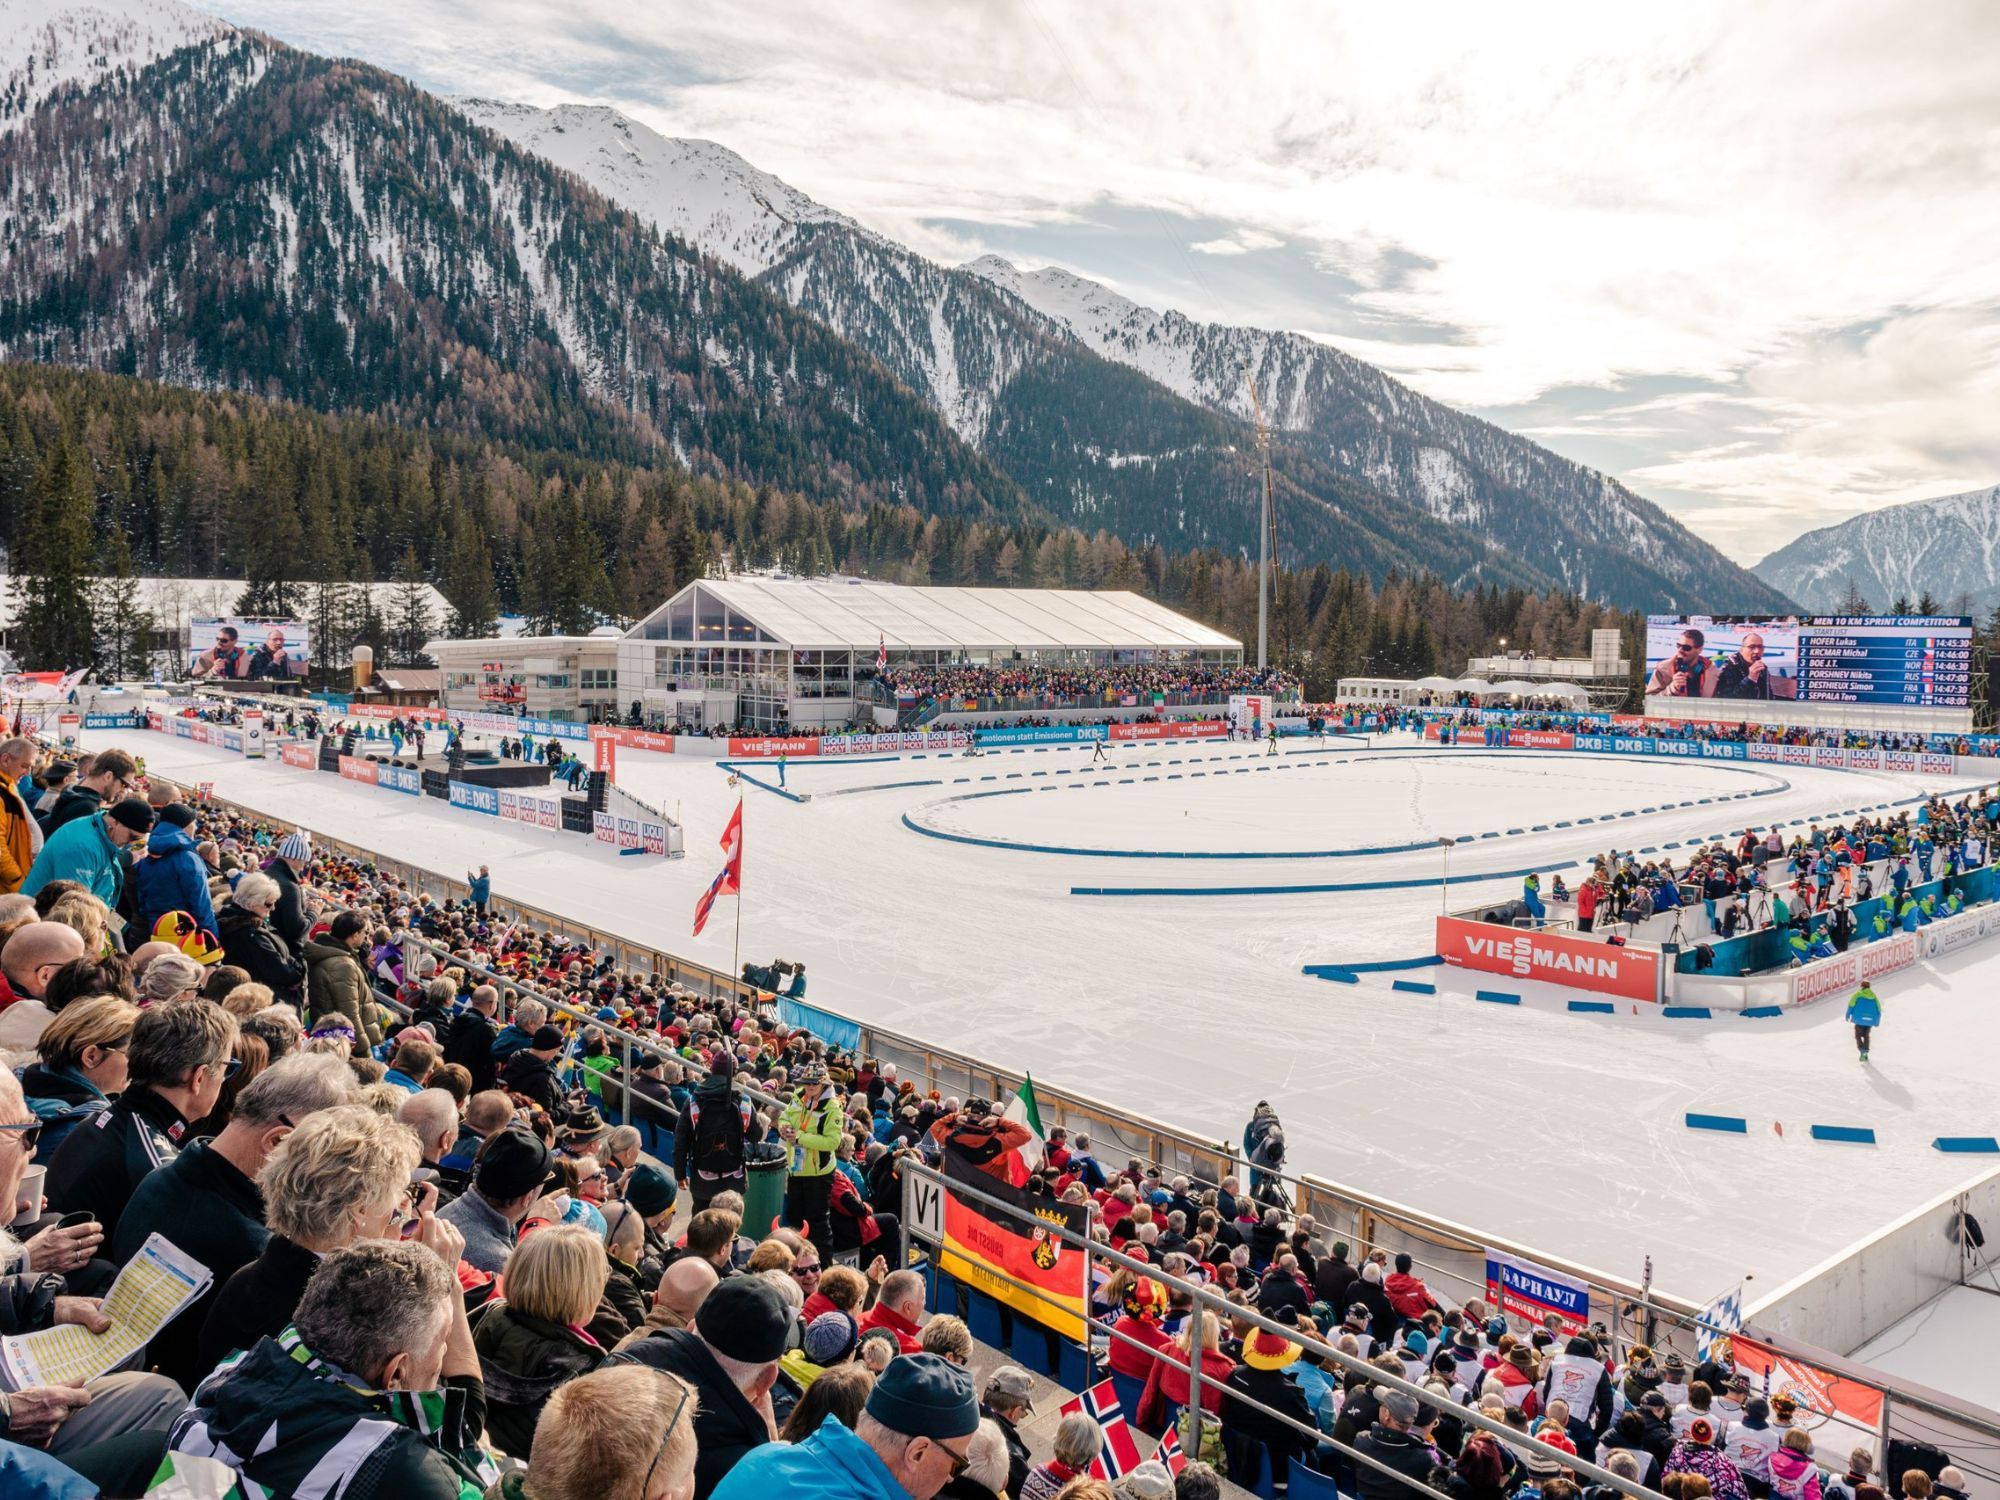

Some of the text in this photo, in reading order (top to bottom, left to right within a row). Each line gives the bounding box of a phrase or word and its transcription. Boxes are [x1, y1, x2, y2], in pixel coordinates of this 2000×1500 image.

[1813, 617, 1960, 626] MEN 10 KM SPRINT COMPETITION
[1813, 628, 1848, 636] START LIST
[1810, 638, 1835, 646] HOFER
[1835, 638, 1857, 646] Lukas
[1905, 639, 1917, 647] ITA
[1936, 639, 1970, 648] 14:45:30
[1809, 648, 1842, 657] KRCMAR
[1842, 649, 1868, 657] Michal
[1905, 650, 1919, 658] CZE
[1935, 650, 1969, 660] 14:46:00
[1809, 659, 1824, 668] BOE
[1825, 659, 1838, 668] J.T.
[1904, 661, 1921, 670] NOR
[1935, 662, 1969, 671] 14:46:30
[1808, 670, 1850, 679] PORSHNEV
[1850, 671, 1873, 680] Nikita
[1904, 672, 1920, 681] RUS
[1934, 673, 1968, 682] 14:47:00
[1808, 681, 1849, 690] DESTHIEUX
[1849, 682, 1874, 690] Simon
[1903, 683, 1919, 692] FRA
[1933, 684, 1968, 694] 14:47:30
[1807, 692, 1840, 701] SEPPALA
[1840, 693, 1857, 701] Tero
[1903, 695, 1916, 703] FIN
[1933, 696, 1967, 706] 14:48:00
[87, 718, 107, 728] DKB
[1179, 722, 1219, 736] VIESSMANN
[877, 734, 899, 743] LIQUI
[903, 733, 924, 742] LIQUI
[928, 732, 948, 741] LIQUI
[980, 731, 1073, 743] motionen statt Emissionen
[1077, 729, 1099, 740] DKB
[1118, 726, 1160, 739] VIESSMANN
[823, 736, 846, 745] LIQUI
[851, 735, 873, 744] LIQUI
[903, 741, 924, 750] MOLY
[928, 740, 948, 749] MOLY
[952, 740, 967, 748] MOL
[1508, 732, 1561, 747] VIESSMANN
[1575, 737, 1602, 750] DKB
[1615, 738, 1643, 752] DKB
[742, 739, 806, 756] VIESSMANN
[823, 745, 846, 754] MOLY
[851, 744, 873, 753] MOLY
[877, 742, 899, 752] MOLY
[1659, 741, 1688, 755] DKB
[1703, 744, 1733, 758] DKB
[1752, 745, 1777, 754] LIQUI
[1784, 747, 1810, 756] LIQUI
[1752, 753, 1777, 761] MOLY
[1784, 755, 1810, 764] MOLY
[1817, 749, 1843, 758] LIQUI
[1852, 751, 1880, 760] LIQUI
[1886, 753, 1915, 762] LIQUI
[1817, 757, 1843, 767] MOLY
[1851, 759, 1879, 769] MOLY
[1886, 761, 1914, 771] MOLY
[1921, 755, 1951, 765] LIQUI
[1921, 764, 1951, 774] MOLY
[378, 768, 392, 786] DKB
[398, 772, 413, 790] DKB
[451, 786, 467, 805] DKB
[472, 790, 491, 809] DKB
[501, 793, 516, 806] LIQUI
[519, 797, 536, 810] LIQUI
[539, 800, 557, 814] LIQUI
[501, 804, 517, 819] MOLY
[519, 808, 537, 824] MOLY
[539, 812, 557, 829] MOLY
[596, 814, 614, 829] LIQUI
[619, 819, 638, 835] LIQUI
[643, 824, 664, 840] LIQUI
[596, 826, 615, 843] MOLY
[618, 832, 638, 849] MOLY
[643, 839, 664, 855] MOLY
[408, 945, 419, 975] V2
[1464, 936, 1618, 979] VIESSMANN
[1622, 951, 1652, 961] VIESSMANN
[1861, 938, 1914, 978] BAUHAUS
[1798, 961, 1856, 1001] BAUHAUS
[913, 1178, 939, 1232] V1
[1503, 1266, 1577, 1308] БАРНАУЛ
